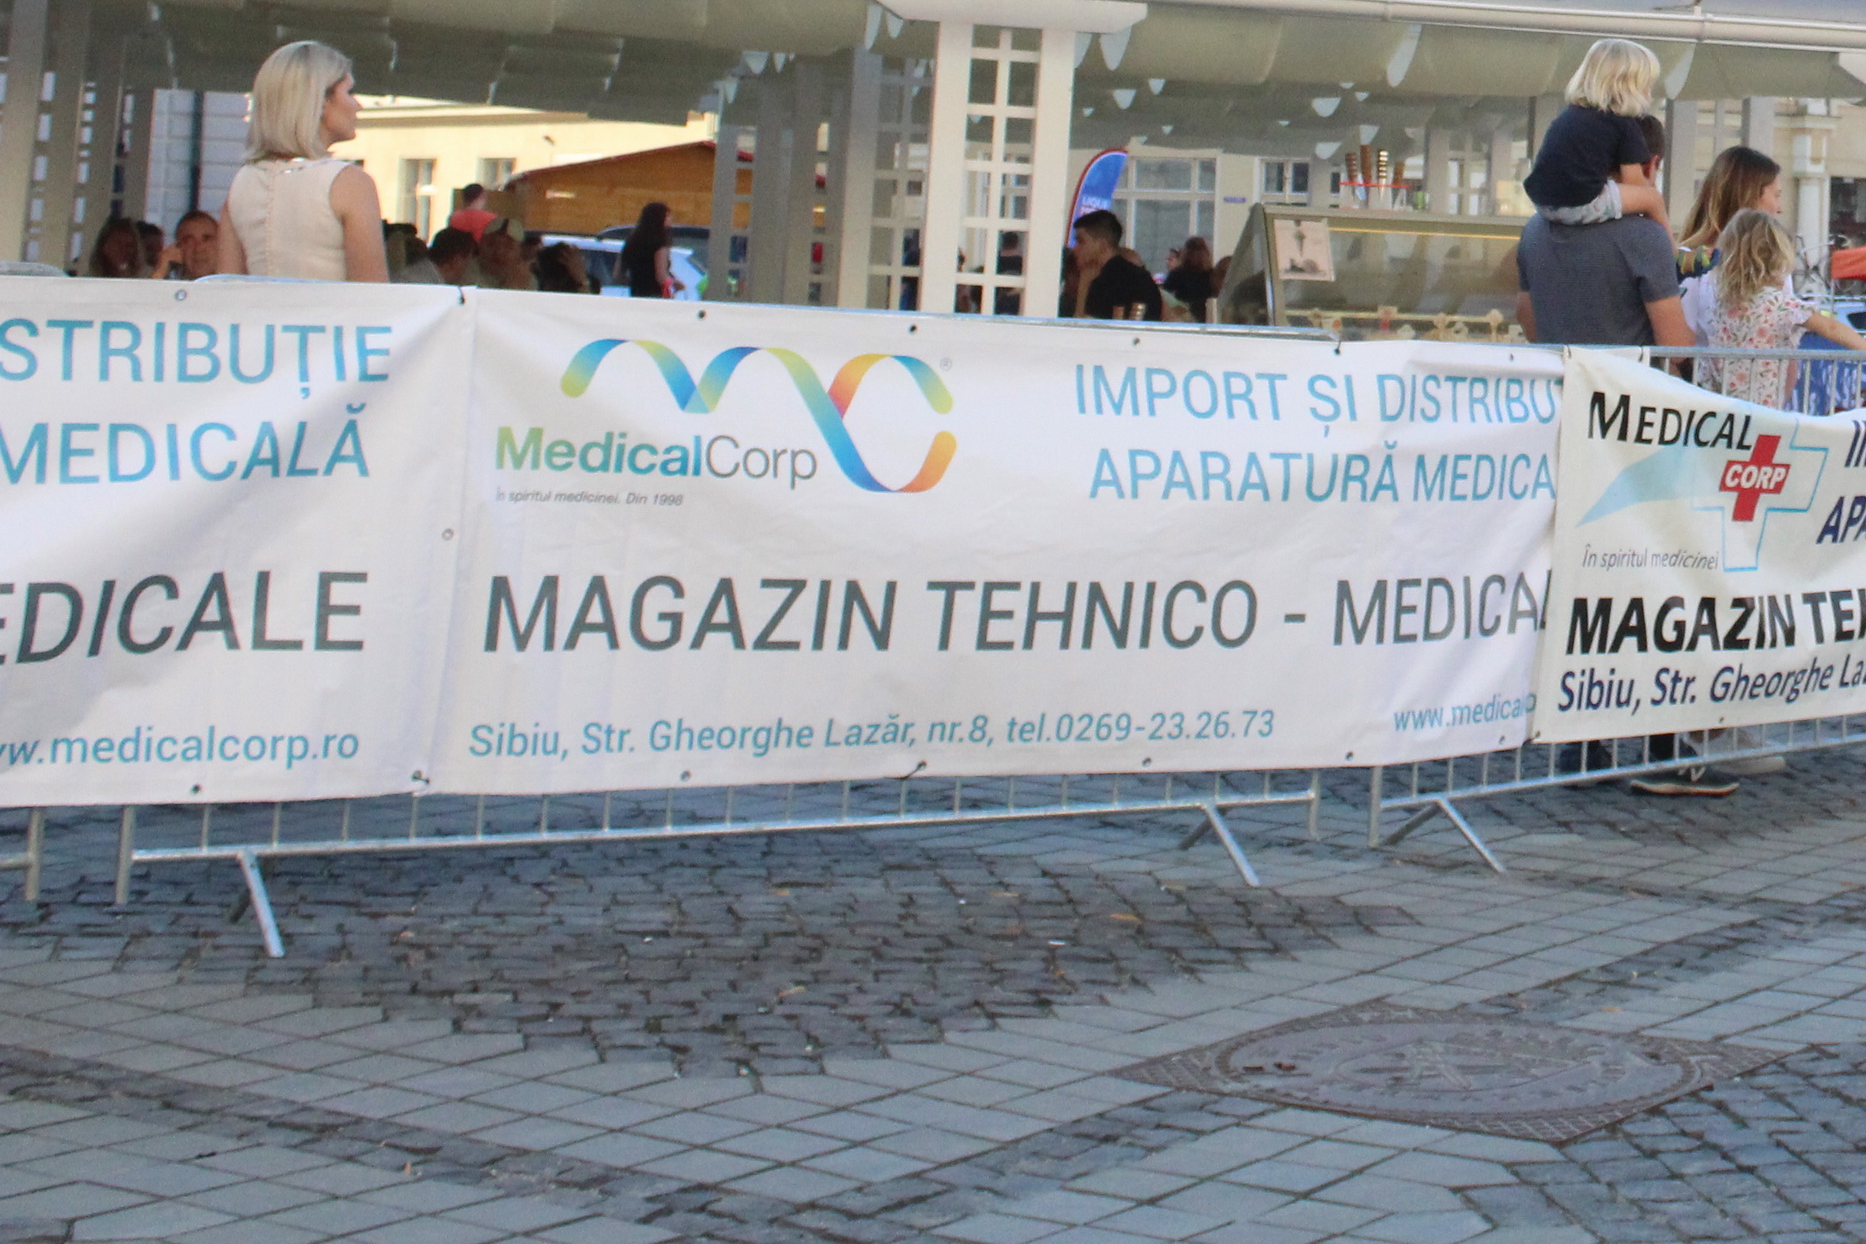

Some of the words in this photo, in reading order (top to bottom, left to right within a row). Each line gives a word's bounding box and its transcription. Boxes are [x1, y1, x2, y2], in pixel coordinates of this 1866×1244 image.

[1076, 364, 1287, 424] IMPORT
[1588, 391, 1753, 451] MEDICAL
[495, 425, 818, 490] MedicalCorp
[1089, 441, 1400, 502] APARATURĂ
[1724, 463, 1788, 490] CORP
[508, 491, 551, 505] spiritul
[625, 492, 649, 505] Din
[1600, 546, 1649, 572] spiritul
[1650, 548, 1719, 571] medicinei
[483, 575, 898, 653] MAGAZIN
[925, 579, 1259, 652] TEHNICO
[1565, 593, 1797, 656] MAGAZIN
[1557, 666, 1642, 717] Sibiu,
[1650, 666, 1697, 707] Str.
[1709, 653, 1832, 705] Gheorghe
[469, 724, 570, 762] Sibiu,
[580, 722, 636, 756] Str.
[649, 718, 814, 759] Gheorghe
